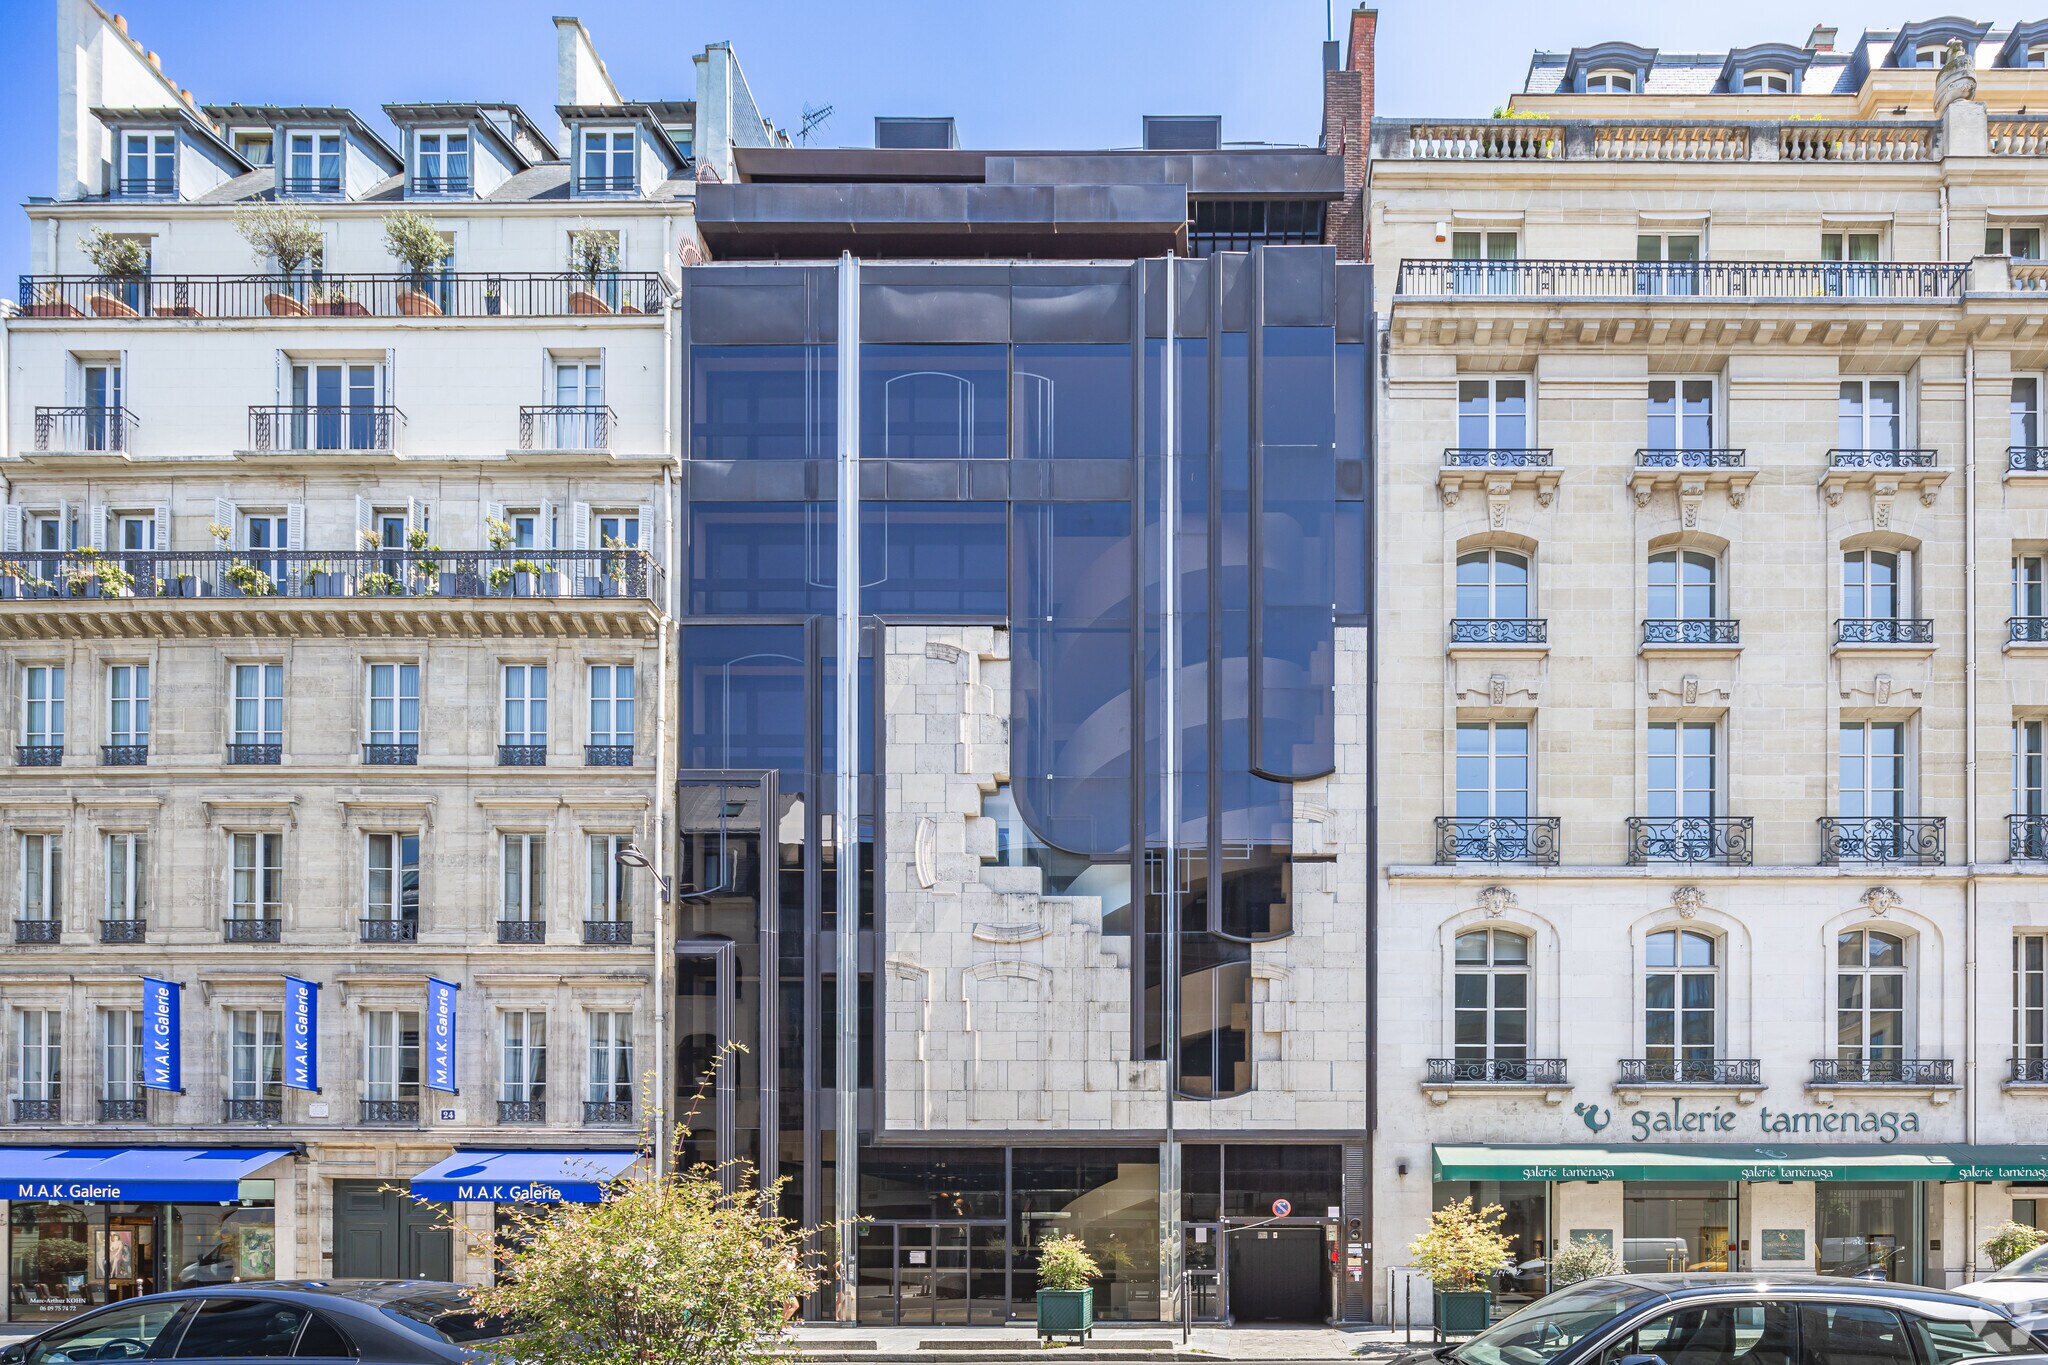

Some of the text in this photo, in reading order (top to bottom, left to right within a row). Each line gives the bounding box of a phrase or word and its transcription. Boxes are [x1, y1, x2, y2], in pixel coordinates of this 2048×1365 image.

[154, 987, 170, 1083] M.A.K. Galerie
[295, 987, 309, 1083] M.A.K. Galerie
[436, 988, 449, 1084] M.A.K. Galerie
[442, 1110, 454, 1119] 24
[1631, 1097, 1920, 1143] galerie taménaga
[1522, 1165, 1615, 1180] galerie taménaga
[1741, 1165, 1834, 1181] galerie taménaga
[1959, 1165, 1994, 1180] galerie
[19, 1184, 121, 1198] M.A.K. Galerie
[458, 1185, 562, 1200] M.A.K. Galerie
